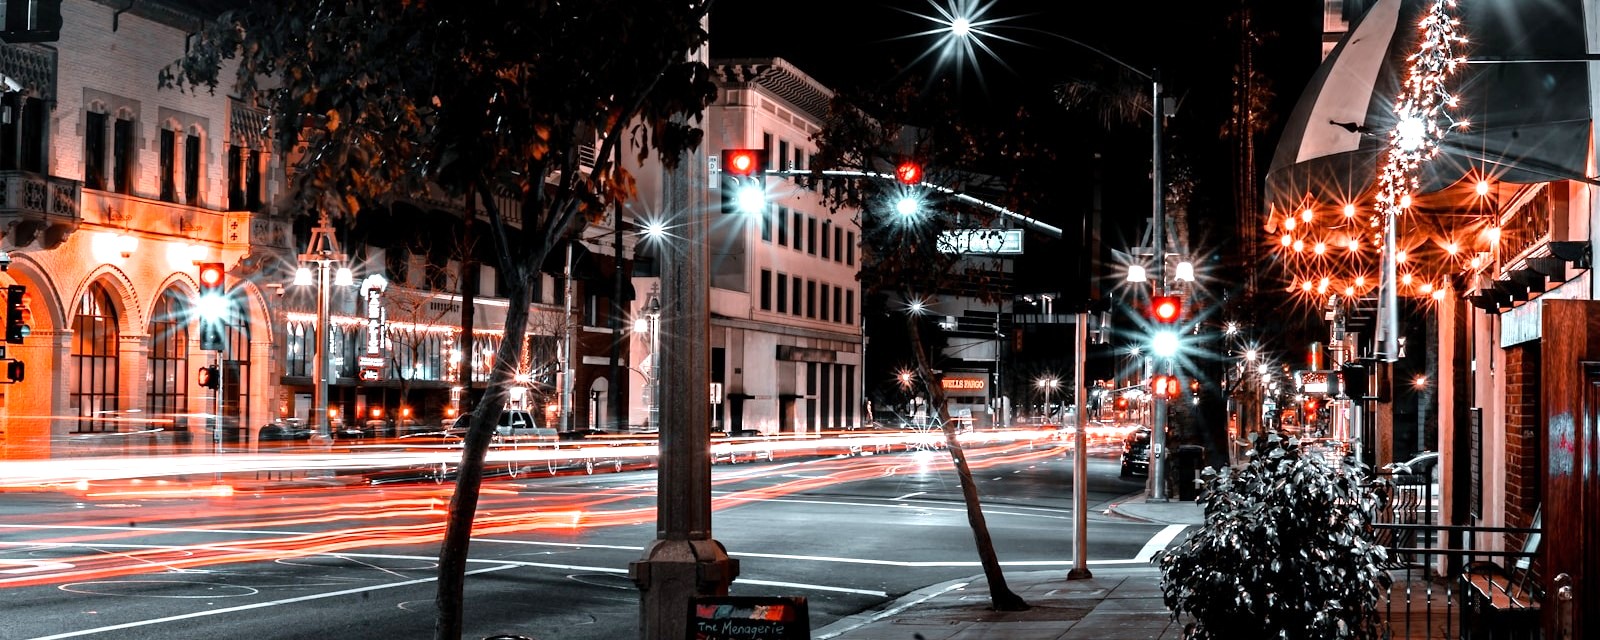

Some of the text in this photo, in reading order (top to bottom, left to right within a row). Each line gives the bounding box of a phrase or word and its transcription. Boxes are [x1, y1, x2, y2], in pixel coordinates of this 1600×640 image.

[941, 379, 985, 389] WELLS FARGO
[721, 620, 785, 640] Menagerie
